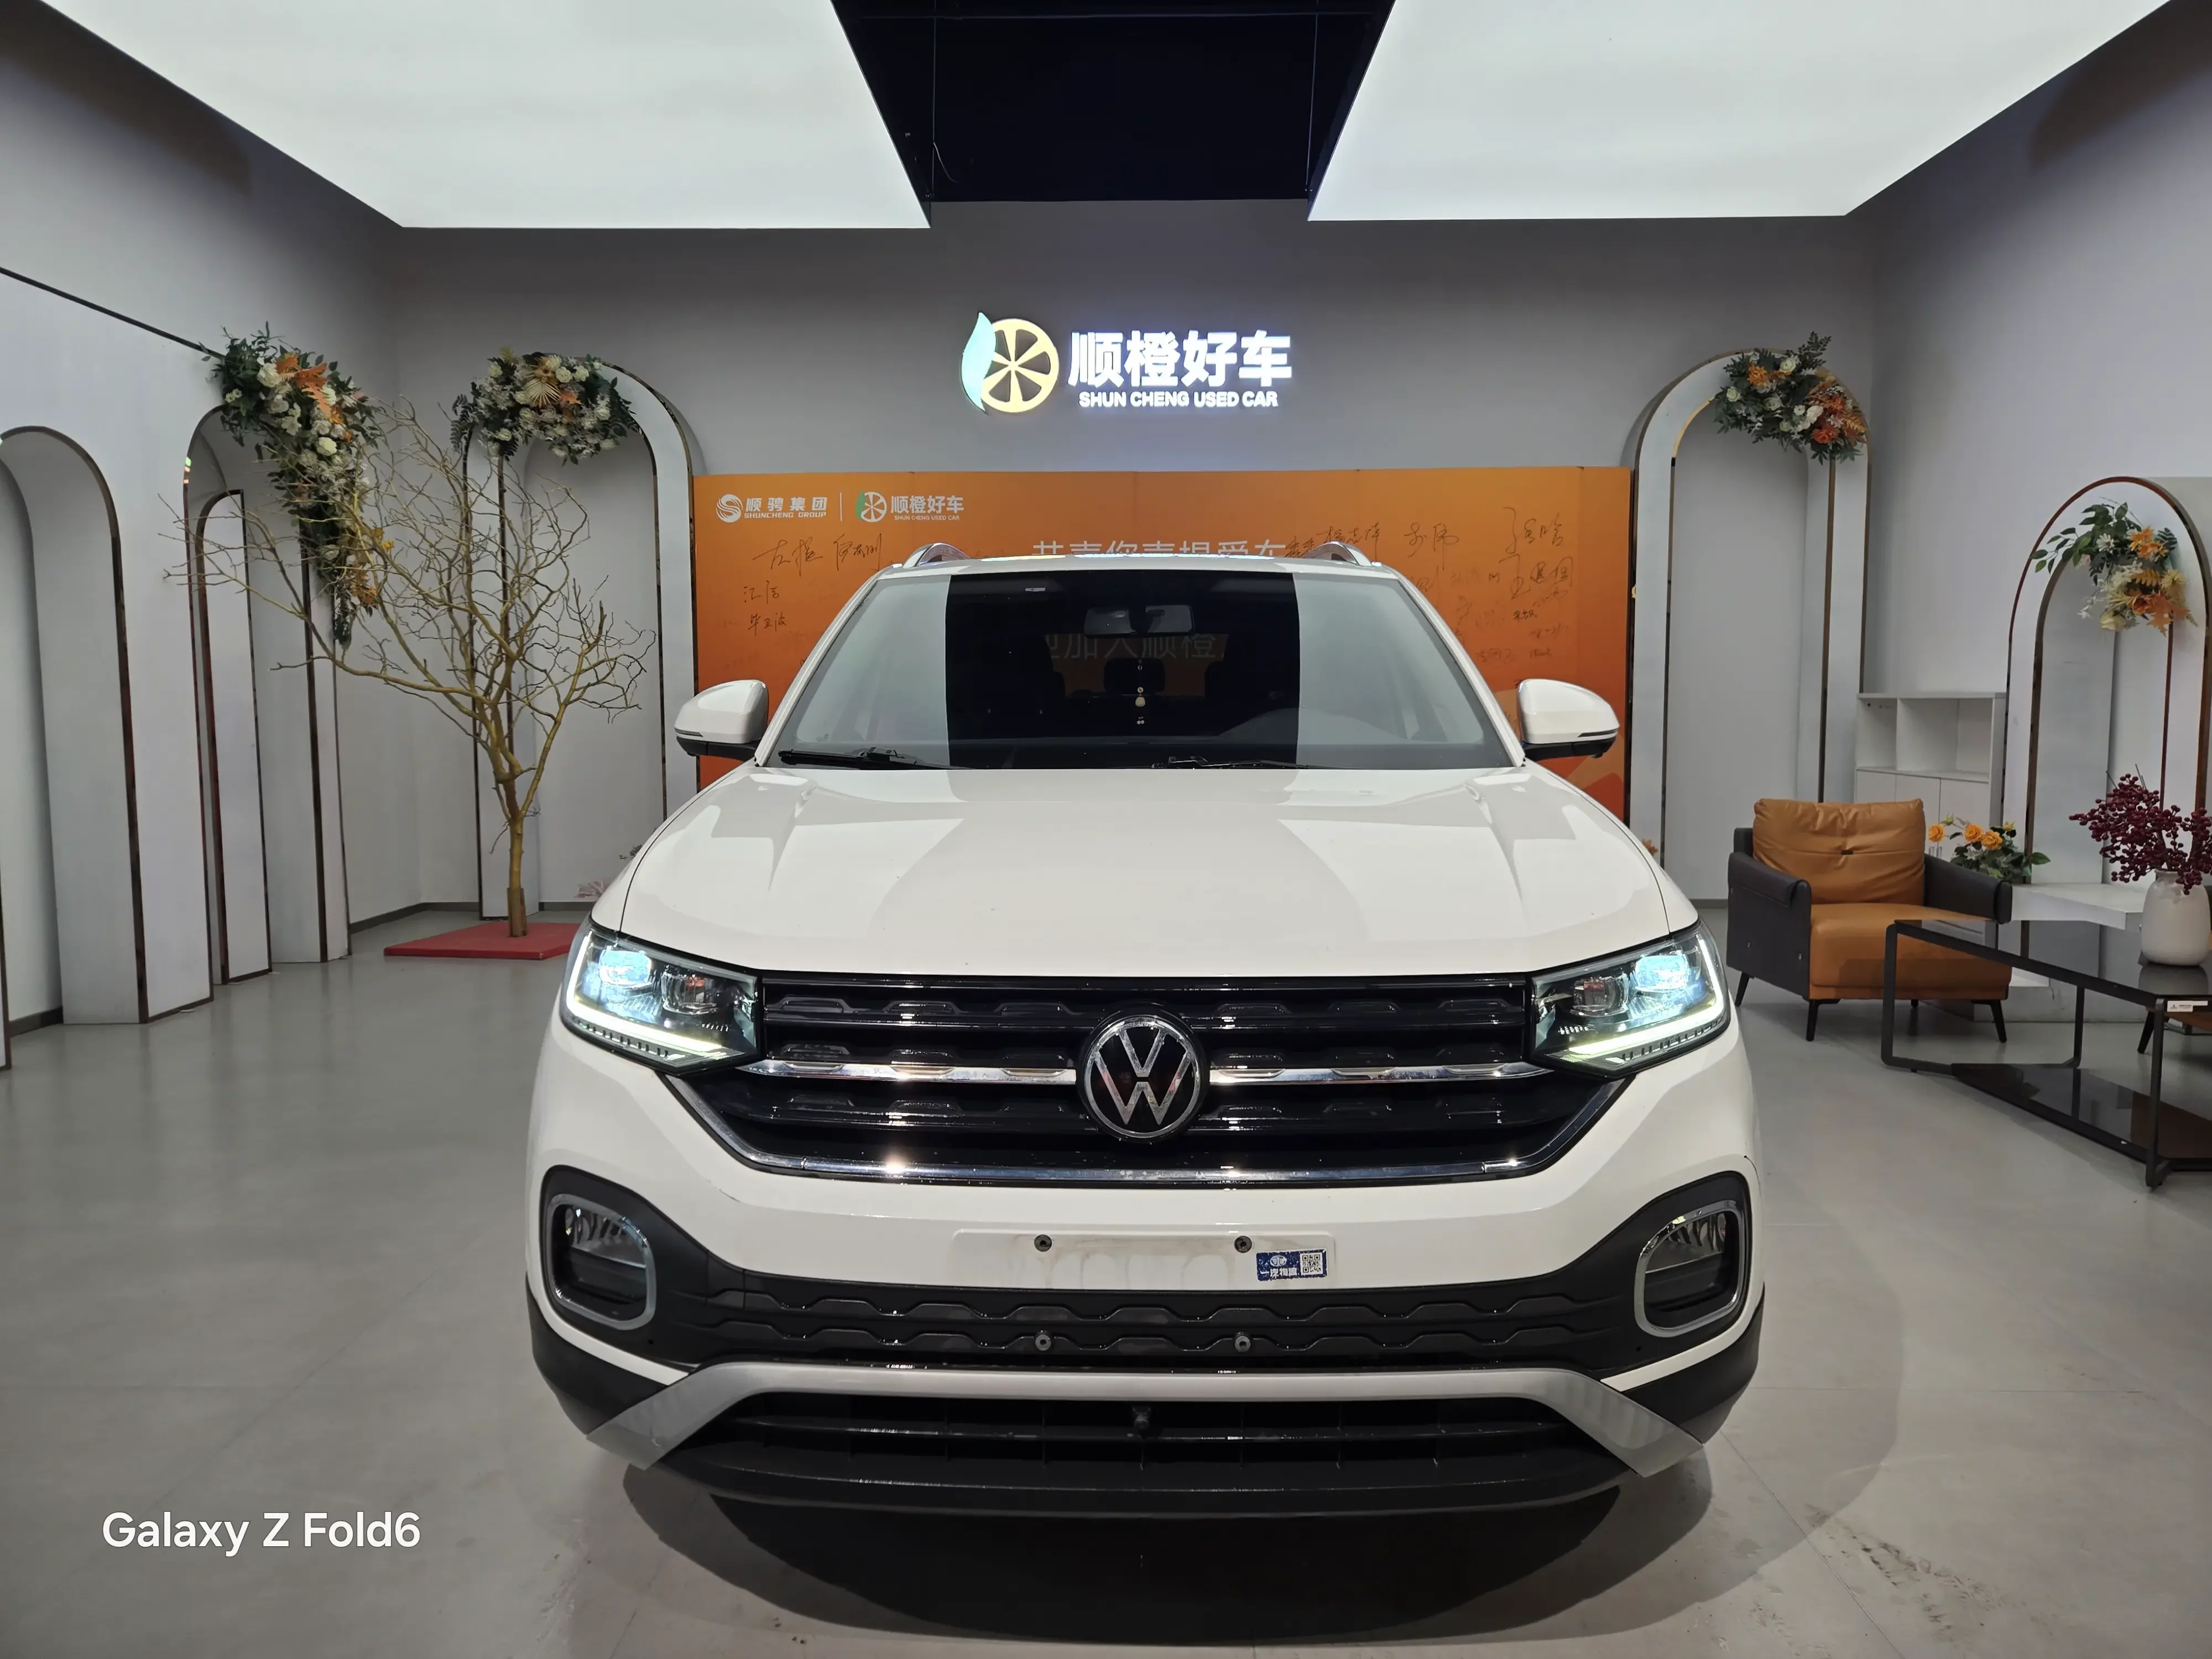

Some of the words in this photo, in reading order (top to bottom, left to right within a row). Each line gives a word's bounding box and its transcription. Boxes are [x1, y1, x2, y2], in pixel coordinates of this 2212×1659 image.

[1068, 330, 1292, 387] 顺橙好车
[1078, 391, 1126, 408] SHUN
[1129, 391, 1190, 408] CHENG
[1193, 391, 1239, 408] USED
[1242, 391, 1279, 408] CAR
[745, 497, 827, 512] 顺骋集团
[890, 495, 964, 514] 顺橙好车
[1045, 634, 1229, 660] 加入顺橙
